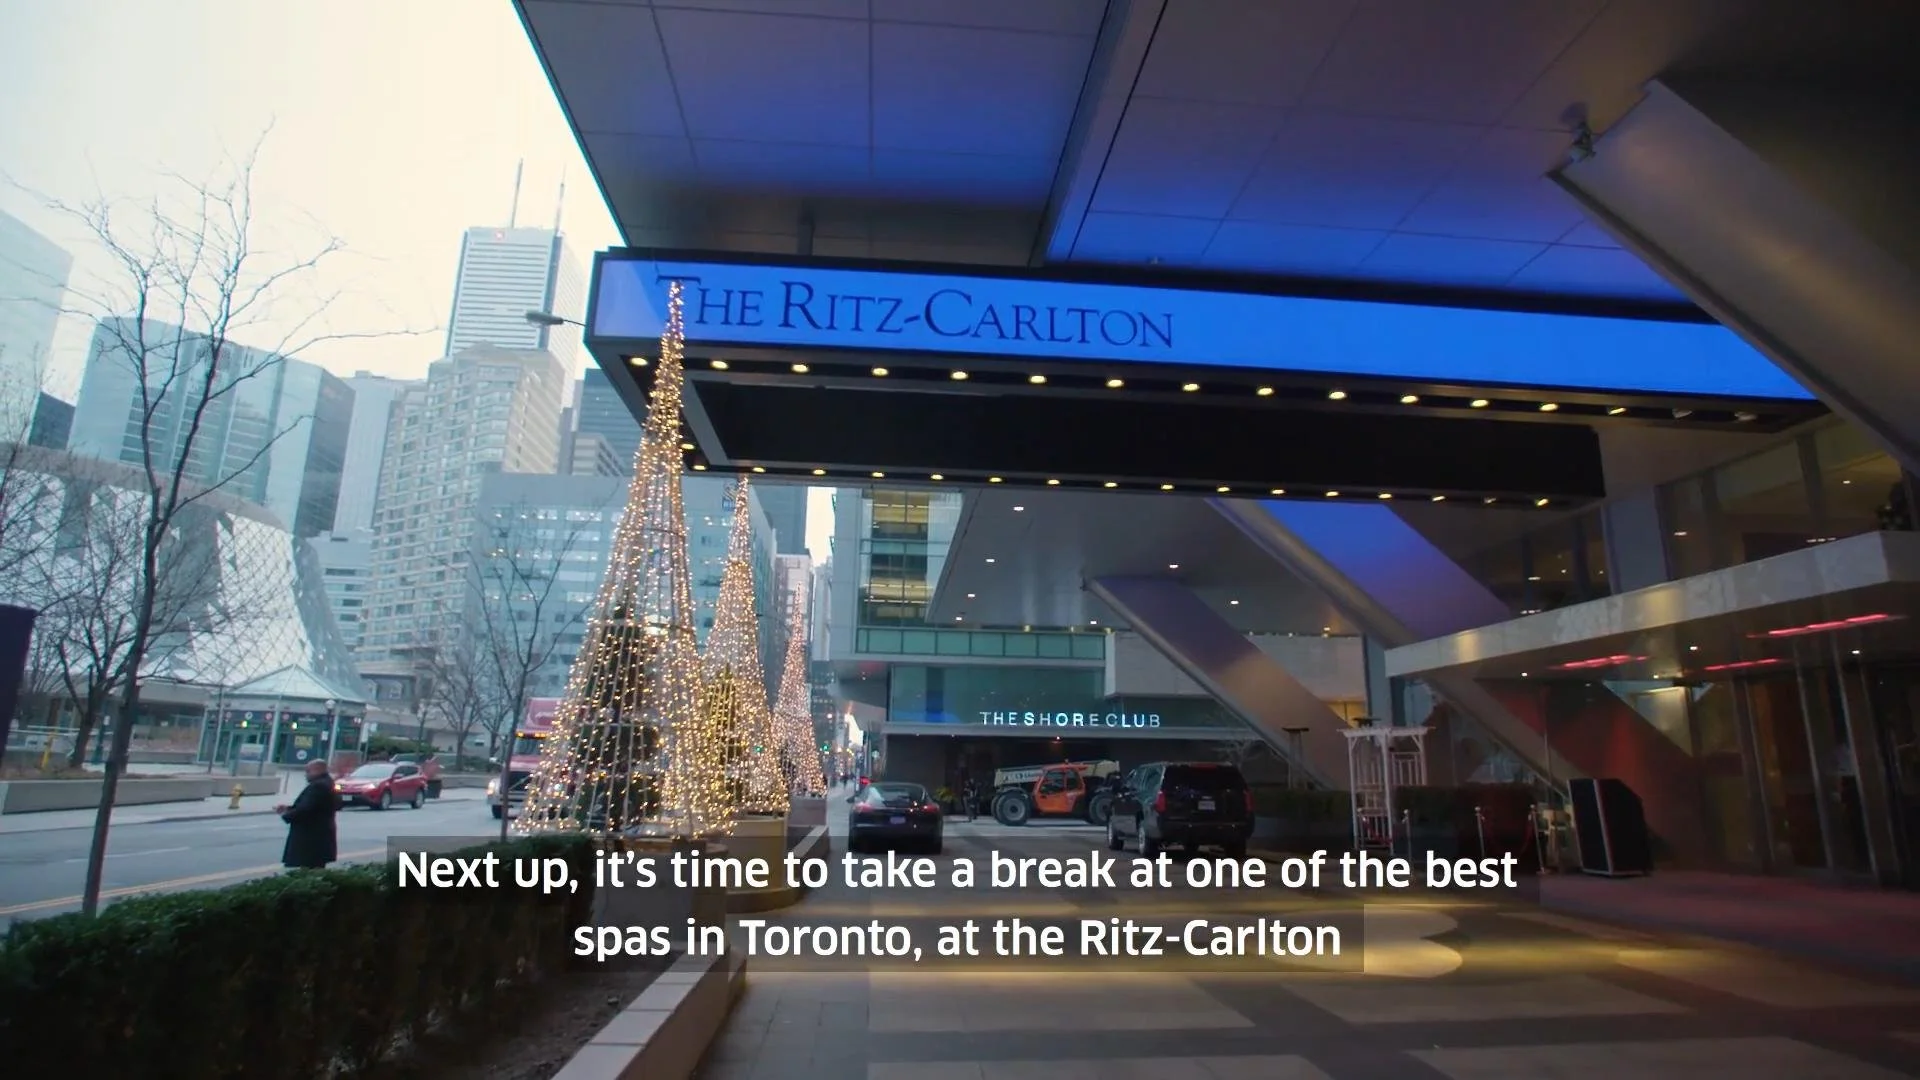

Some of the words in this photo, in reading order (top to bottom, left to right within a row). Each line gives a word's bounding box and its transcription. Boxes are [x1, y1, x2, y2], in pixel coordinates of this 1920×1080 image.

[657, 275, 763, 330] THE
[778, 280, 1173, 349] RITZ-CARLTON
[979, 711, 1018, 726] THE
[1023, 711, 1099, 727] SHORE
[1105, 713, 1161, 728] CLUB
